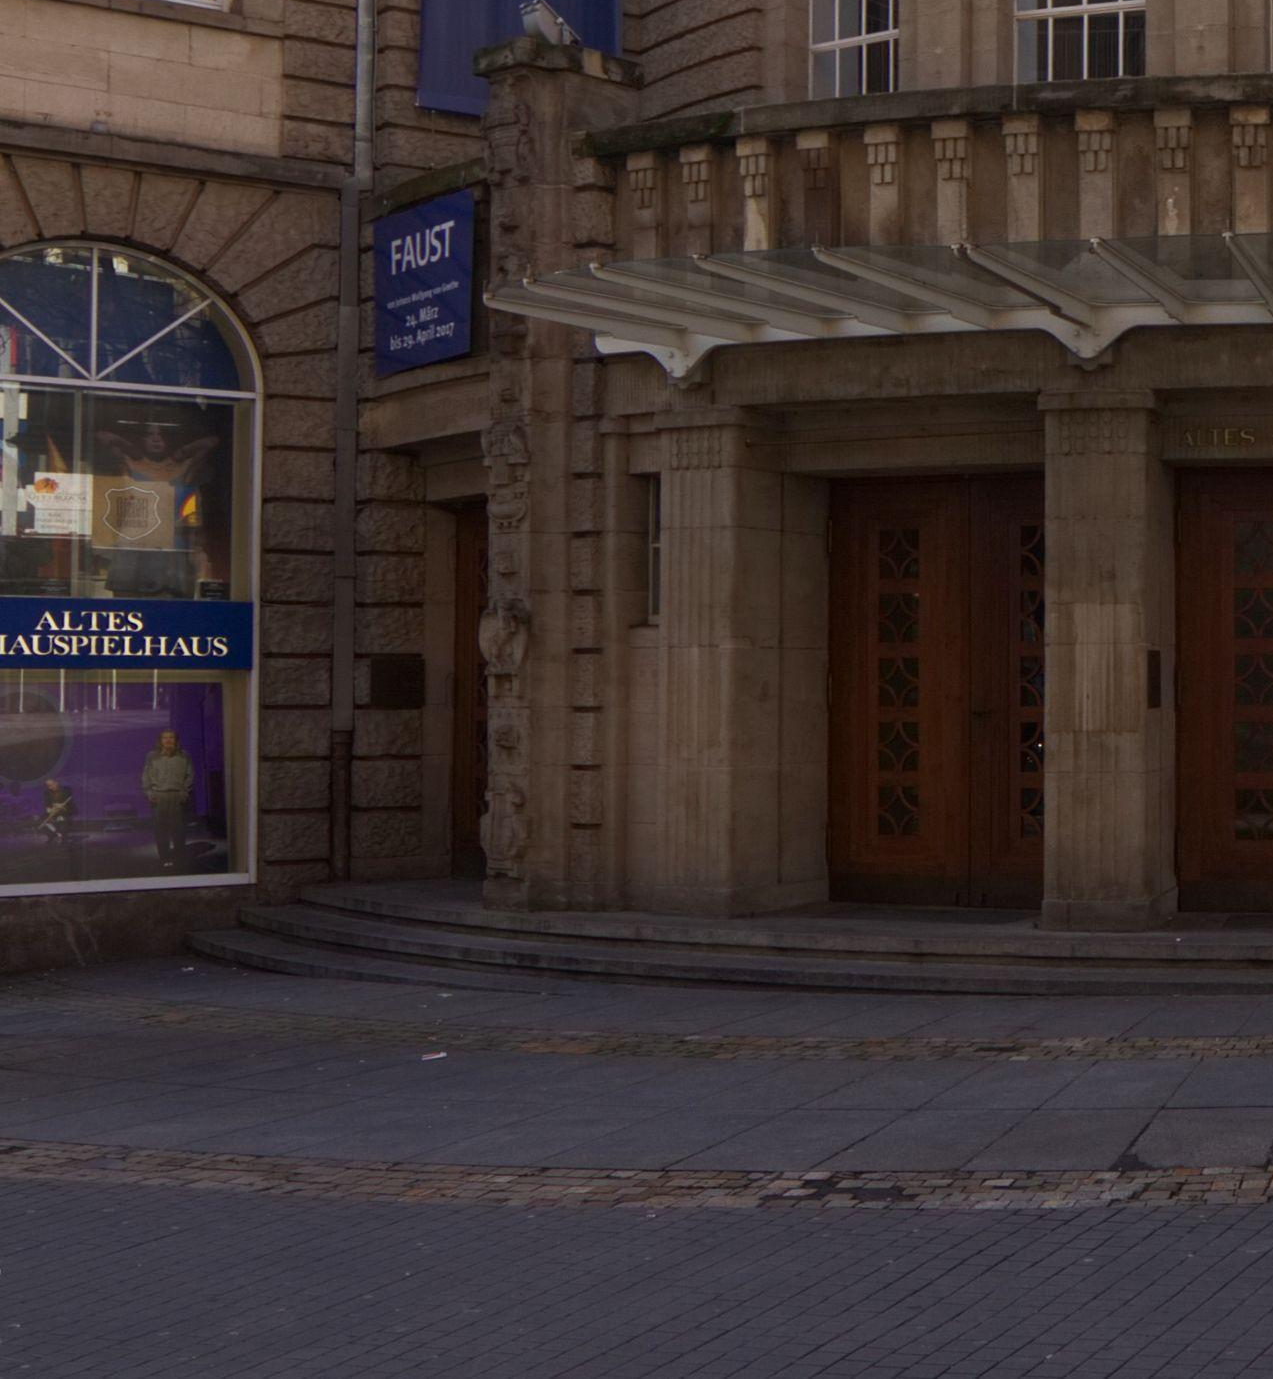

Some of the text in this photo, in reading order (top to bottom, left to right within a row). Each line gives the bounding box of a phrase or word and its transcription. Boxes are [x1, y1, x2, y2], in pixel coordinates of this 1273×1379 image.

[391, 220, 455, 276] FAUST
[405, 305, 440, 327] 24. März
[390, 322, 455, 351] bis 29. April 2017
[1180, 426, 1256, 447] ALTES
[35, 610, 145, 632] ALTES
